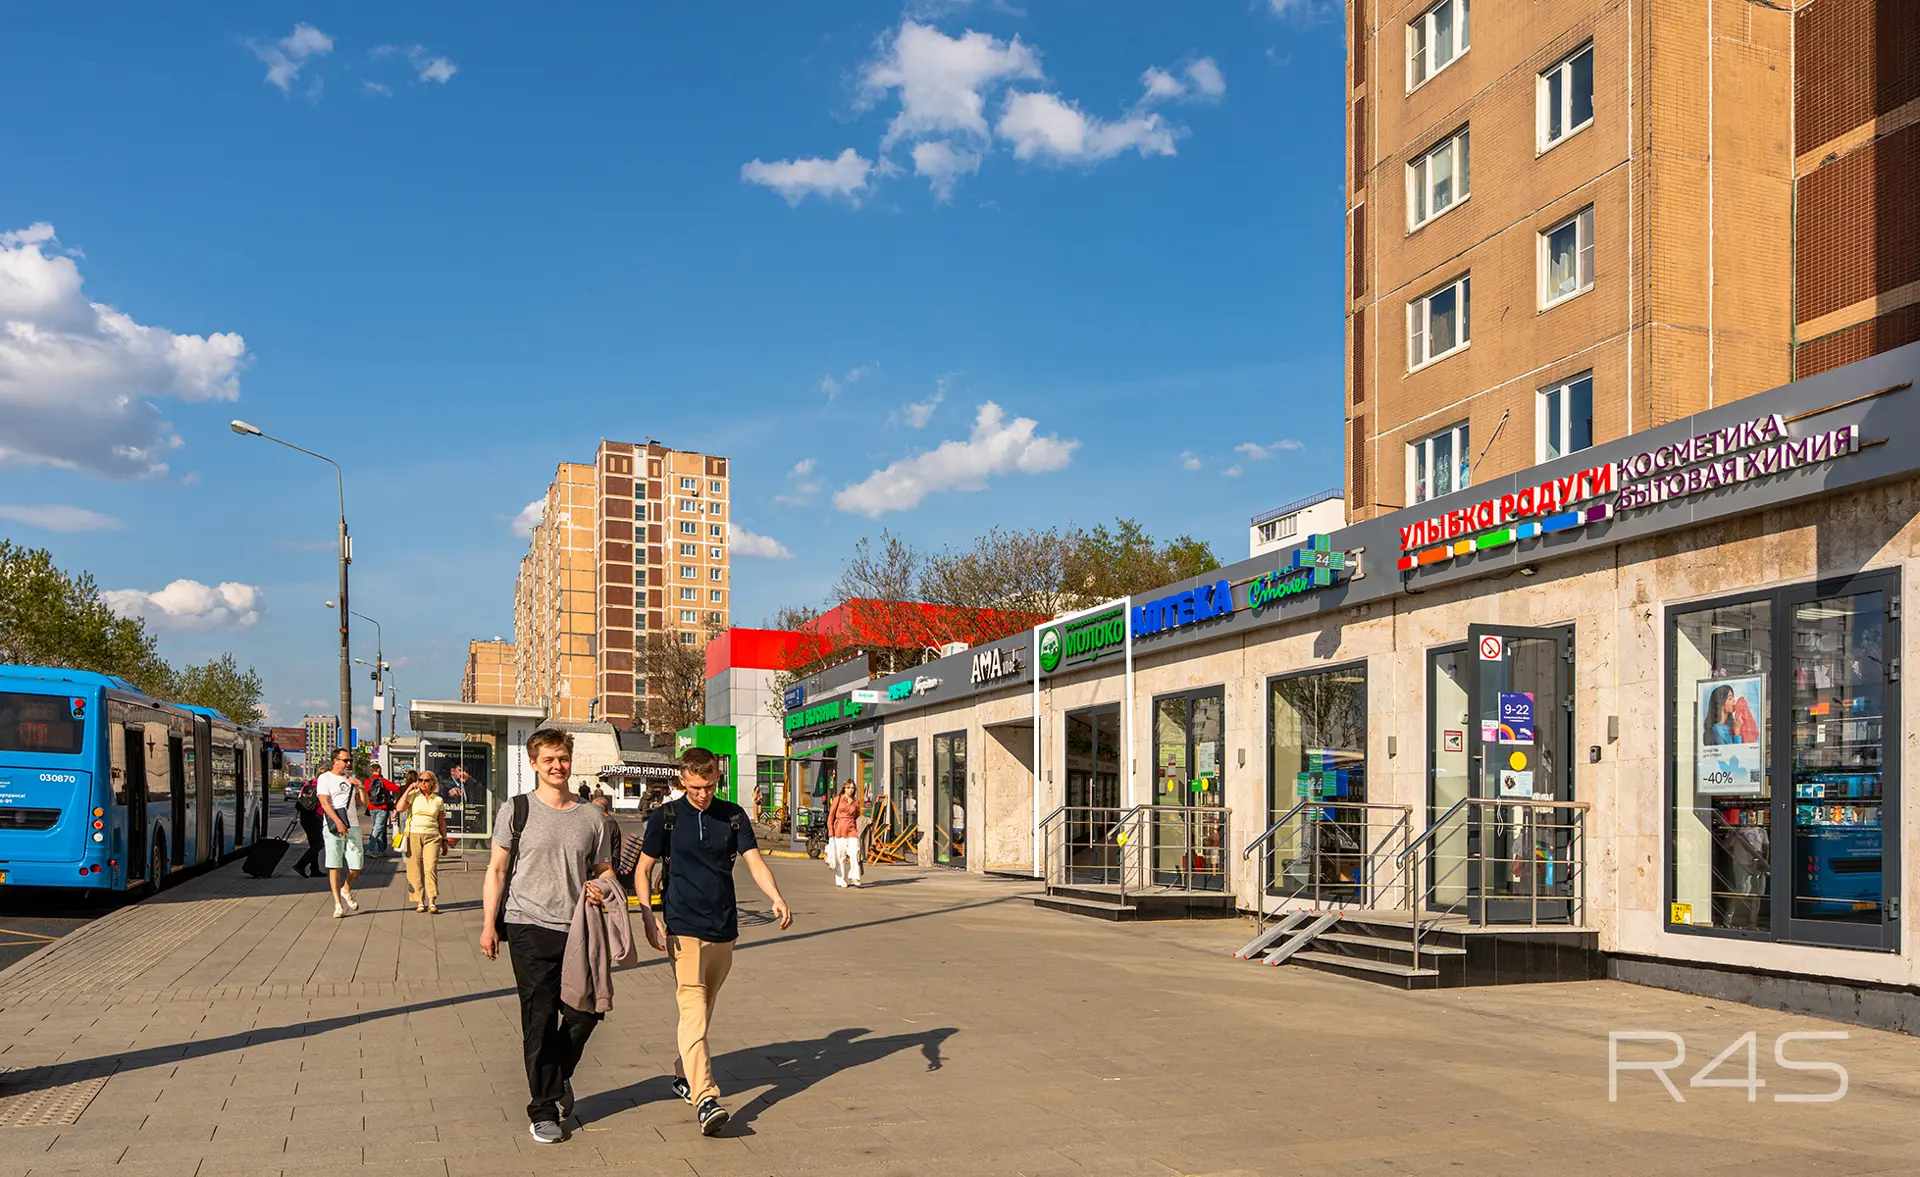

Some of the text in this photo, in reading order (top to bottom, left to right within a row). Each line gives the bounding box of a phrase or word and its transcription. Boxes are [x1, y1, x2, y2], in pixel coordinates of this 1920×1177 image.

[1620, 413, 1784, 481] КОСМЕТИКА
[1619, 424, 1854, 509] БЫТОВАЯ ХИМИЯ
[1399, 462, 1615, 550] УЛЫБКА РАДУГИ
[1315, 553, 1330, 566] 24
[1131, 579, 1235, 638] АПТЕКА
[1064, 619, 1125, 658] МОЛОКО
[1504, 704, 1530, 715] 9-22
[39, 773, 76, 784] 030870
[602, 765, 680, 777] ШАУРМА ХАЛЯЛЬ
[1703, 771, 1733, 784] -40%
